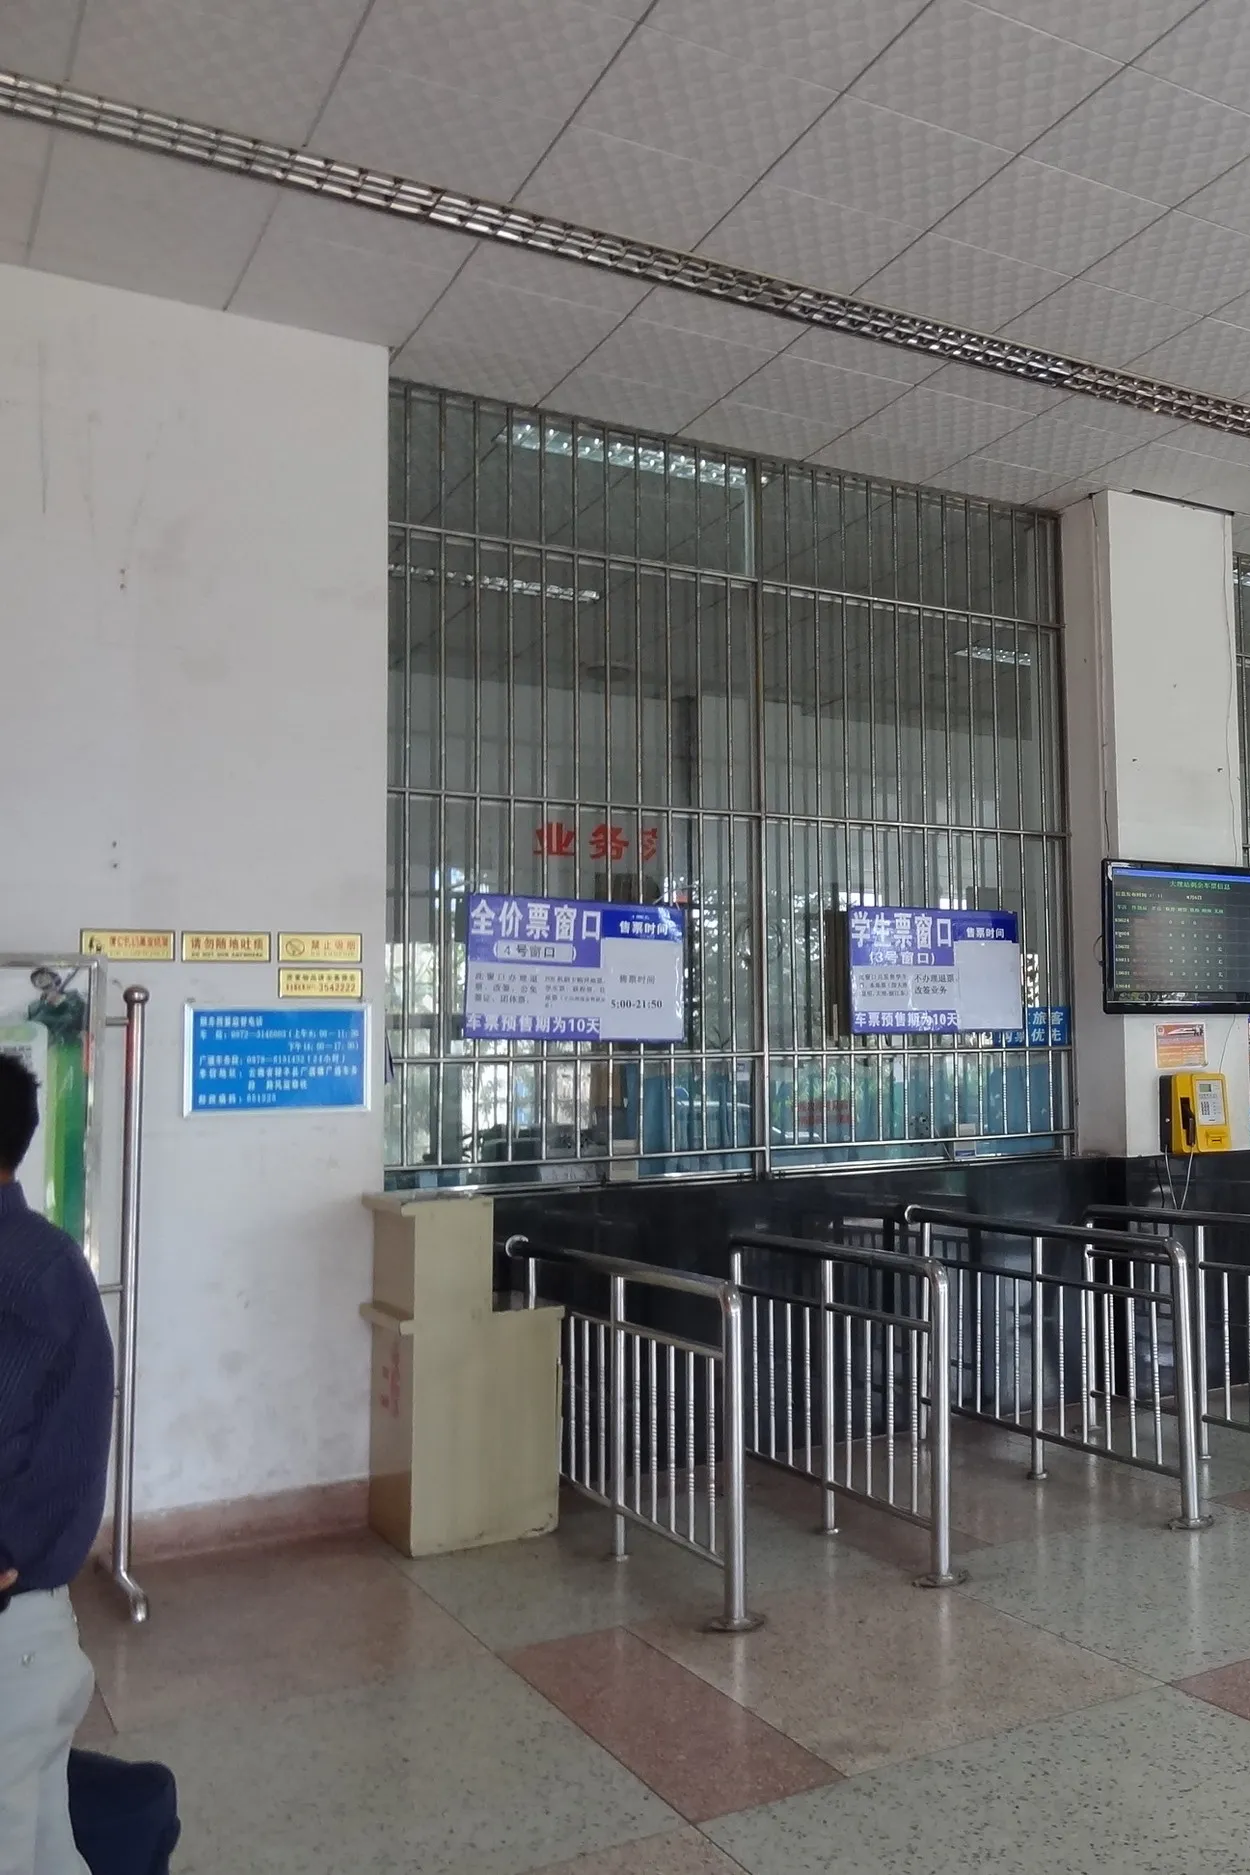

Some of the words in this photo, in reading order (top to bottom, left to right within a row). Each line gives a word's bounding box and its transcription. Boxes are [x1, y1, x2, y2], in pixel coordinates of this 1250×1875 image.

[471, 899, 601, 941] 全价票窗口
[620, 920, 669, 936] 售票时间
[851, 911, 952, 949] 学生票窗口
[966, 926, 1005, 939] 售票时间
[620, 975, 656, 985] 售票时间
[610, 999, 663, 1010] 5:00-21:50
[465, 1013, 601, 1034] 车票预售期为10天
[854, 1011, 959, 1028] 车票预售期为10天
